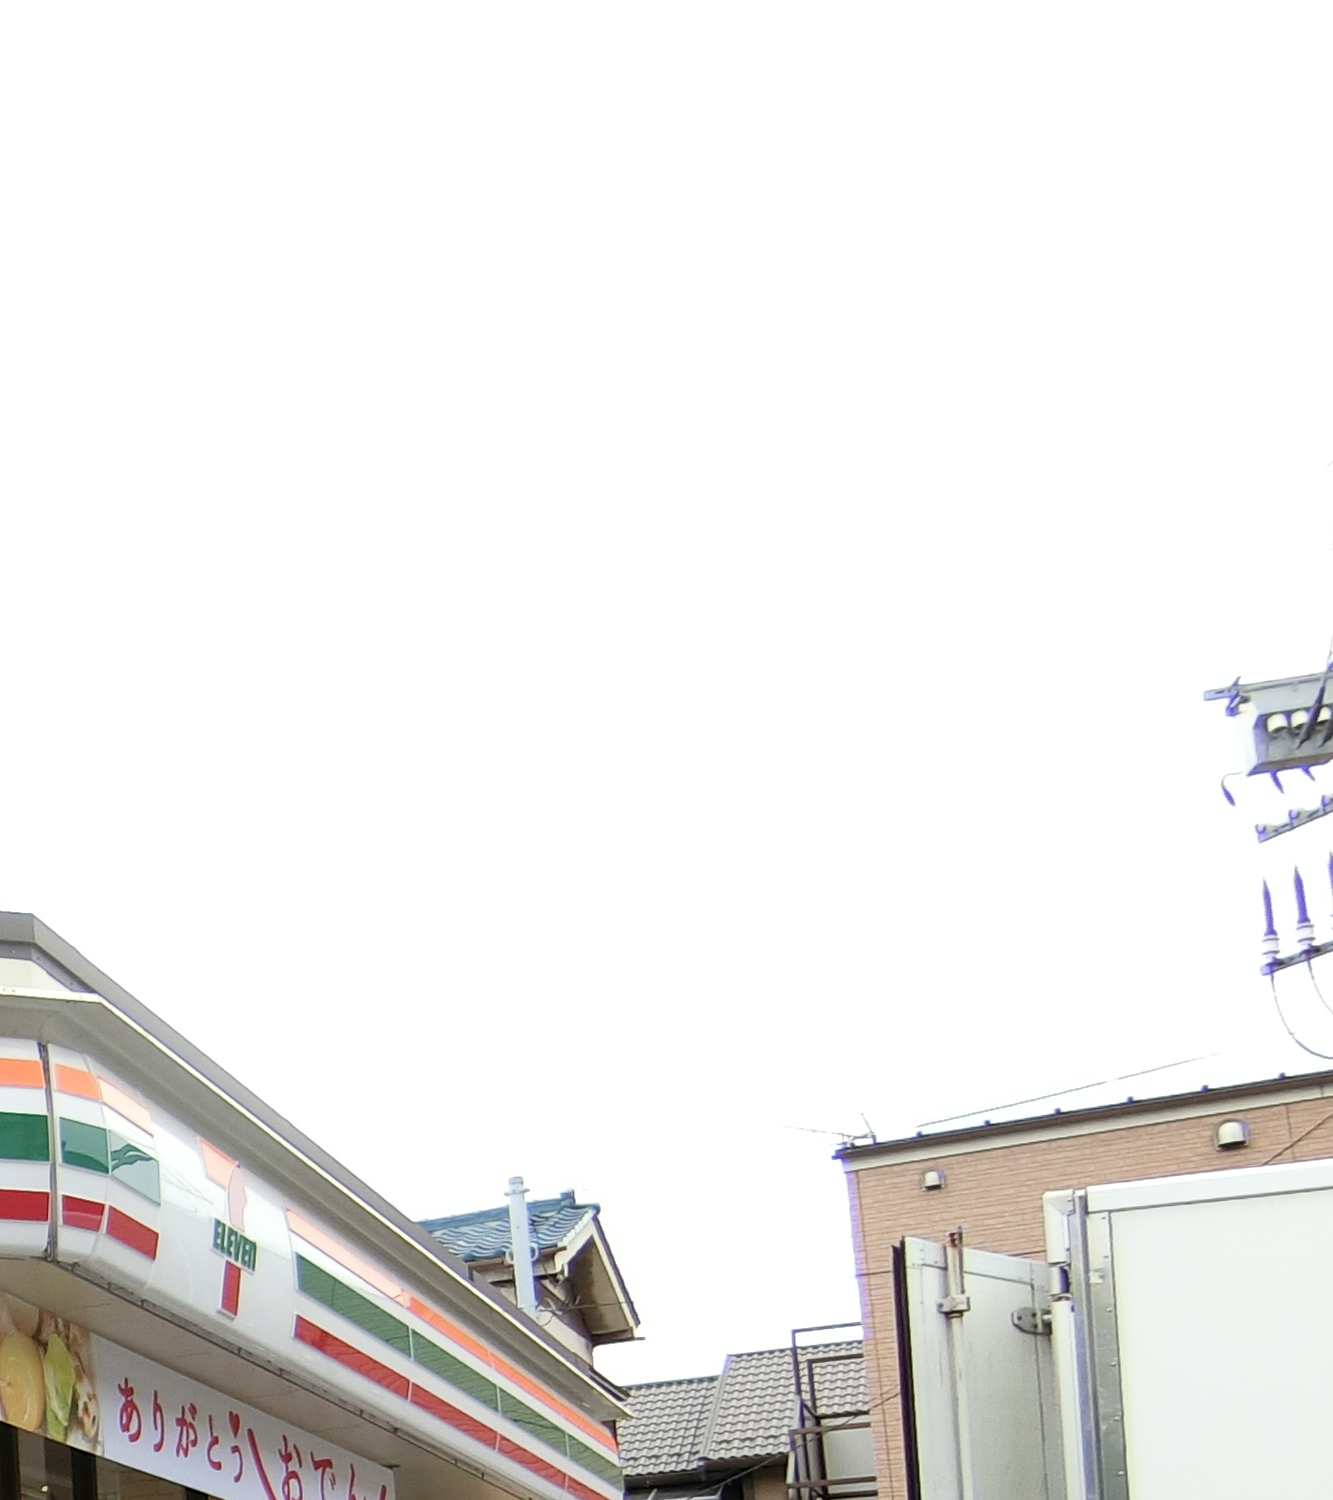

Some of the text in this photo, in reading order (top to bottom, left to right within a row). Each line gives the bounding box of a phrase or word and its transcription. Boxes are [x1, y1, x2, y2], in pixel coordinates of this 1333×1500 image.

[117, 1376, 244, 1484] ありがとう
